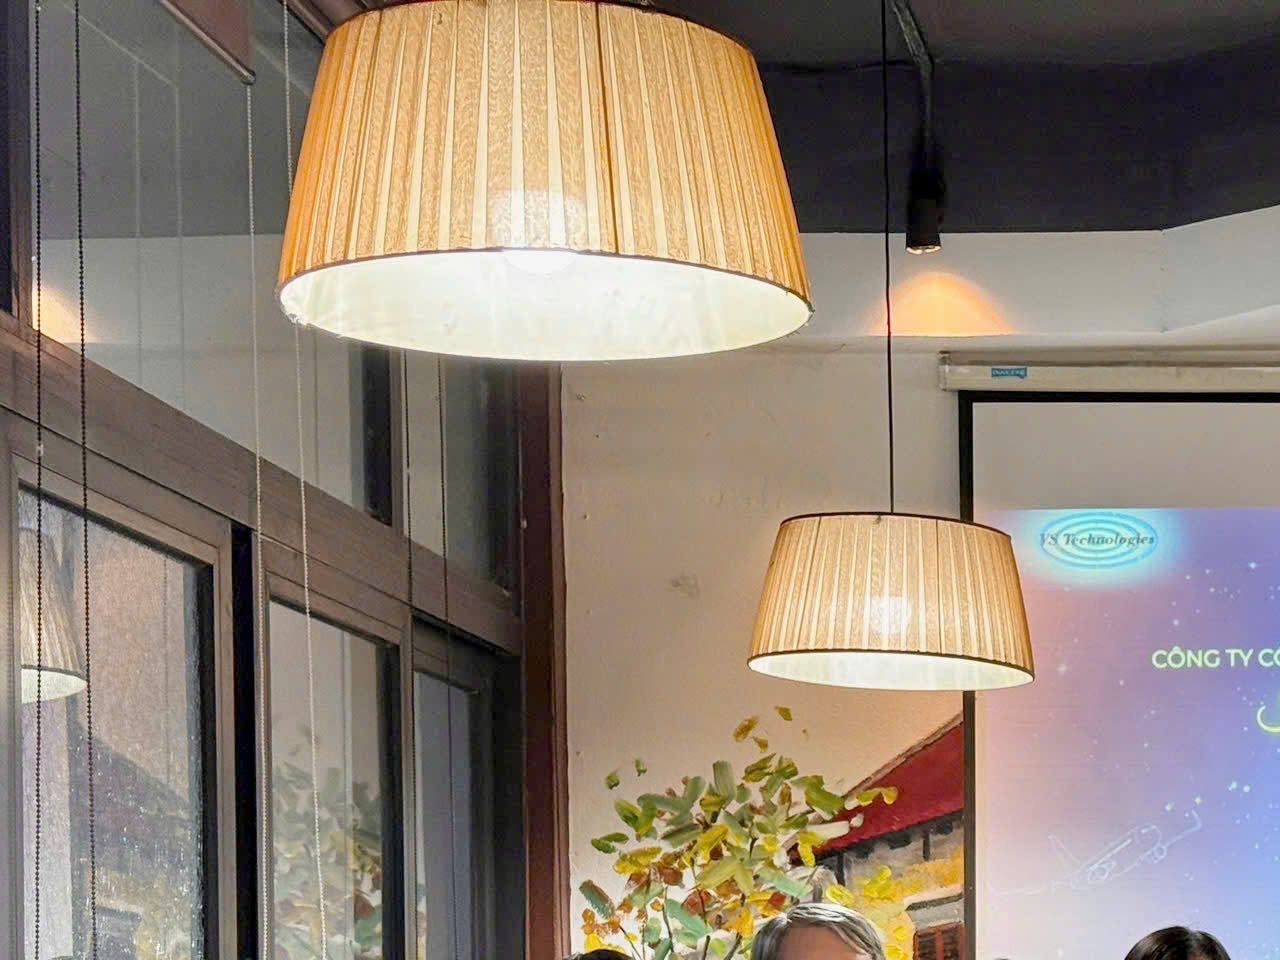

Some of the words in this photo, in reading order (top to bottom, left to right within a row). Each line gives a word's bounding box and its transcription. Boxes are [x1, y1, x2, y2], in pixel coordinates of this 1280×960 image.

[1040, 532, 1058, 546] VS
[1063, 531, 1155, 548] Technologies
[1151, 646, 1221, 669] CÔNG
[1225, 648, 1254, 668] TY
